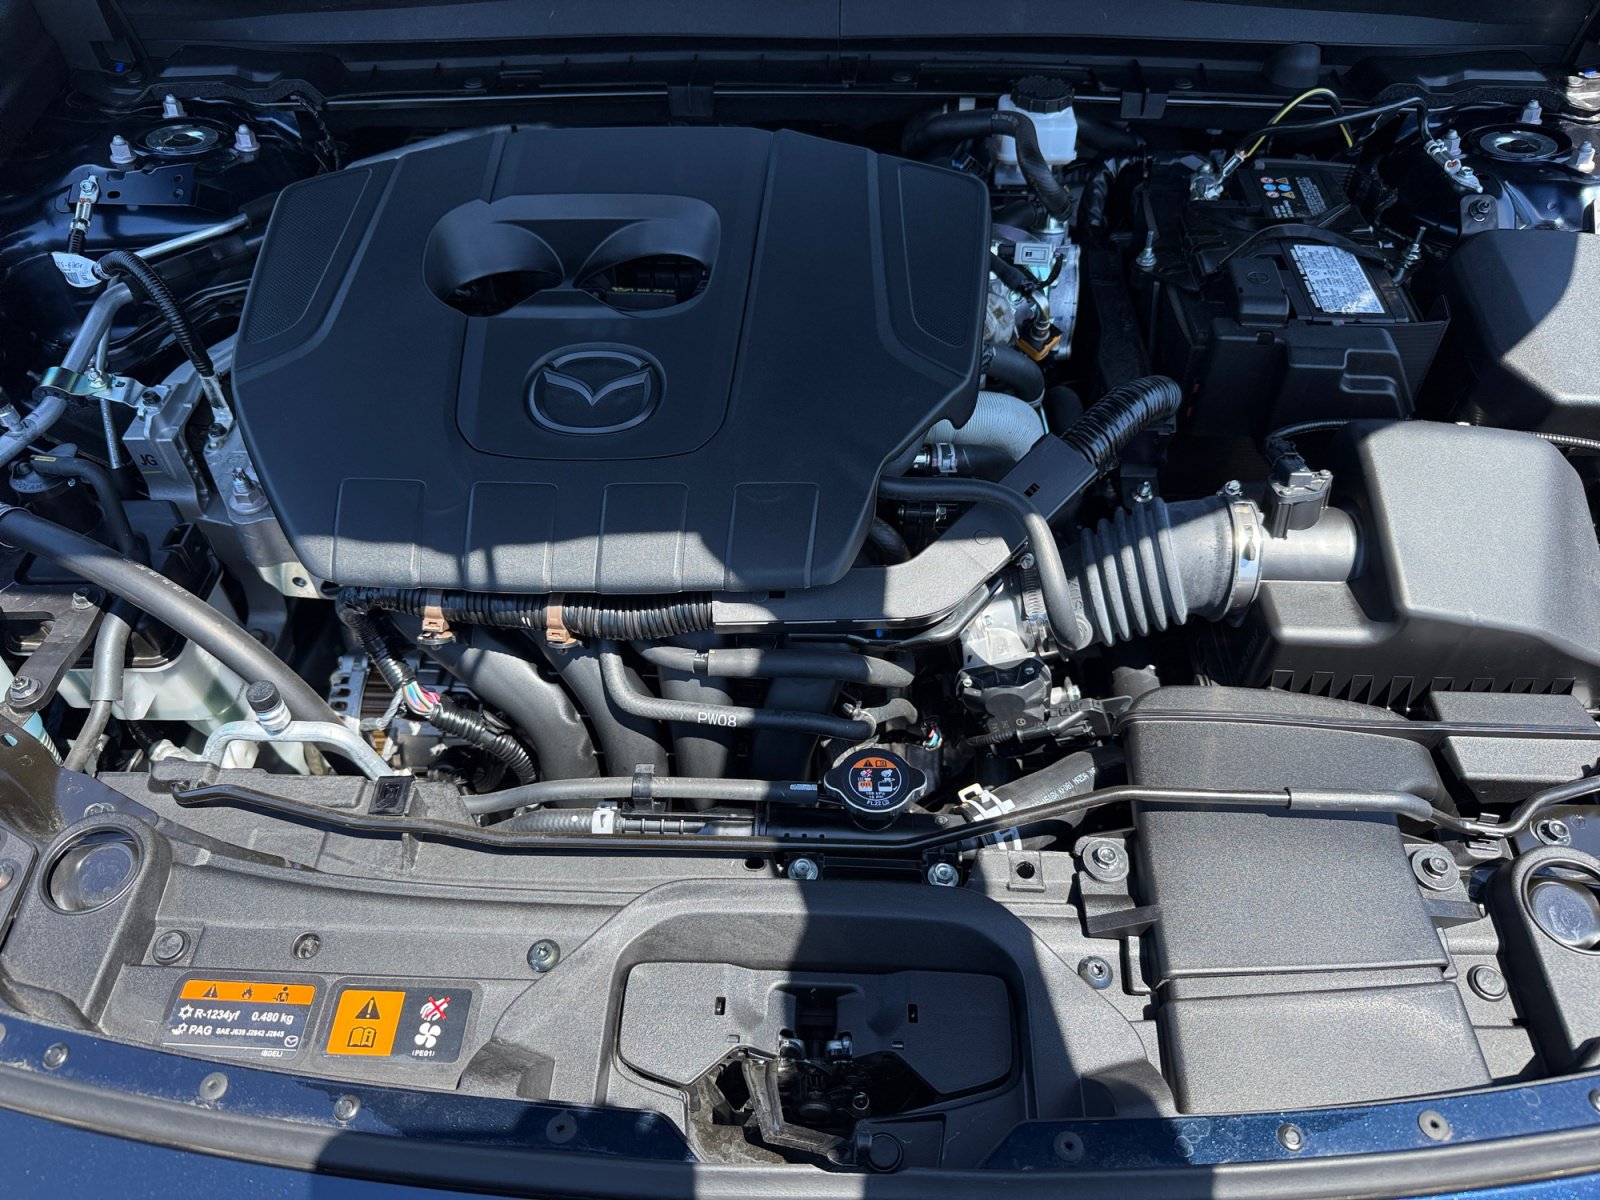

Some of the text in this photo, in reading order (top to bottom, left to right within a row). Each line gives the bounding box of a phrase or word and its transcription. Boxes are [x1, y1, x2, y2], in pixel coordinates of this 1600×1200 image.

[139, 453, 159, 467] JG
[697, 711, 737, 727] PW08
[194, 1008, 295, 1025] R-1234yf 0.480 kg
[188, 1024, 213, 1036] PAG
[215, 1027, 230, 1036] SAE
[411, 1049, 436, 1057] (PE01)
